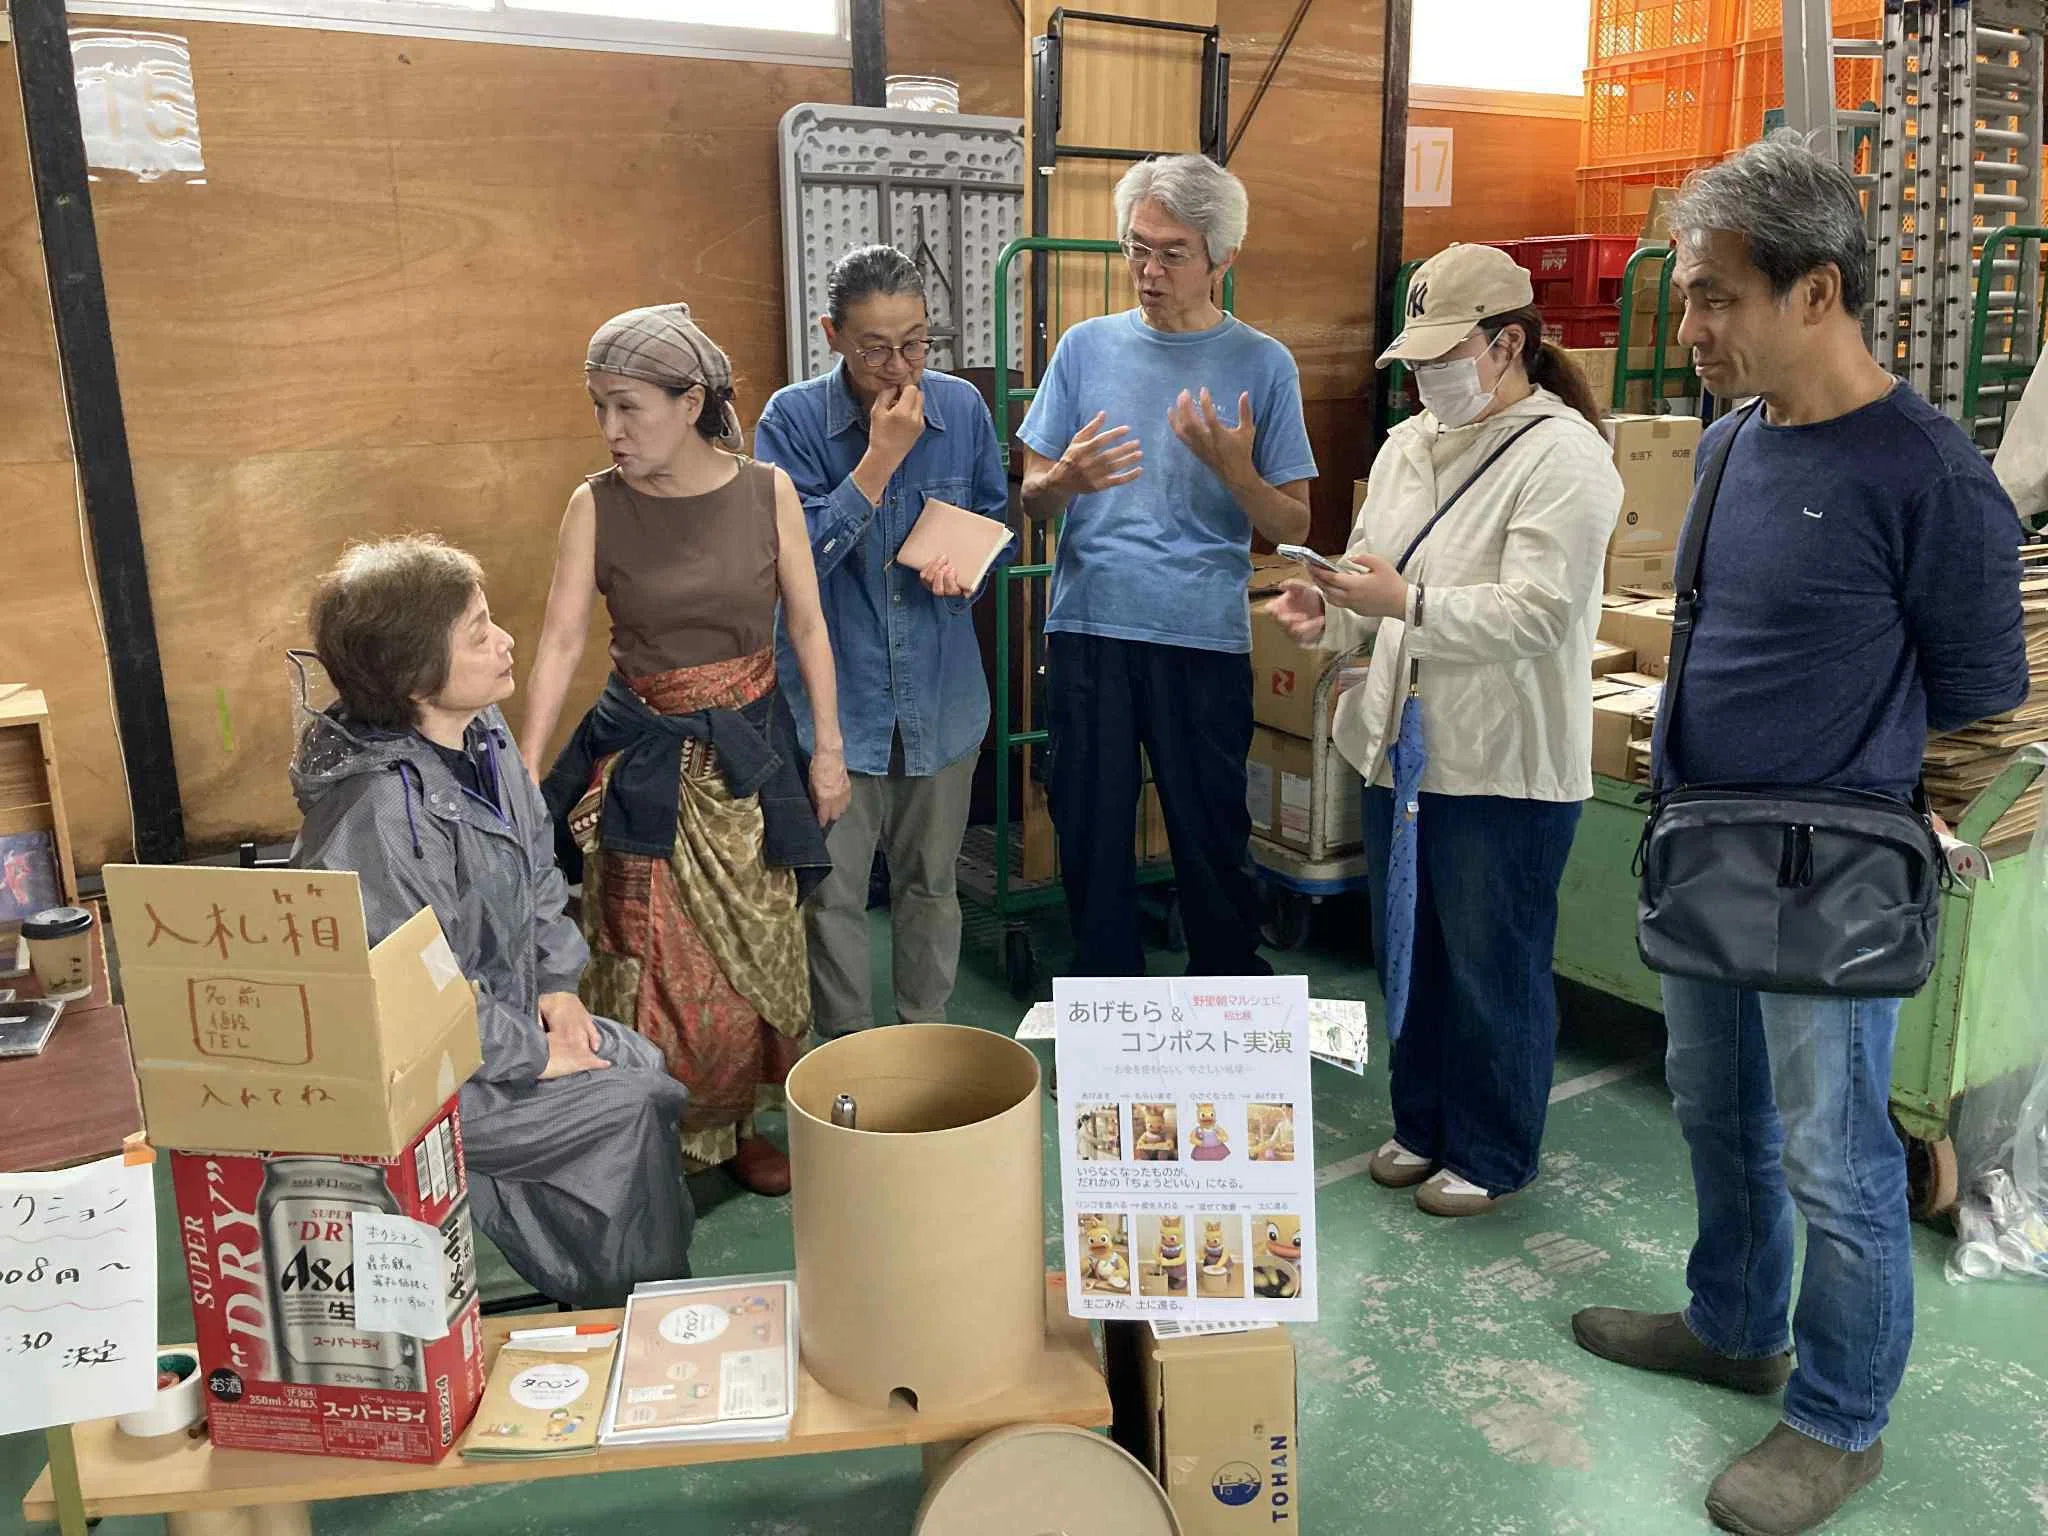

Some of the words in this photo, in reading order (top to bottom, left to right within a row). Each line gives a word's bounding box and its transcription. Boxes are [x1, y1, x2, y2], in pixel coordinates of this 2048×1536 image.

[1410, 140, 1450, 193] 17
[144, 883, 340, 961] 入札箱
[205, 984, 261, 1009] 名前
[1068, 1000, 1163, 1024] あげもら
[1170, 1007, 1184, 1023] &
[205, 1031, 250, 1049] TEL
[1120, 1029, 1294, 1055] コンポスト実演
[200, 1083, 337, 1109] 入れてね
[0, 1188, 128, 1226] クション
[184, 1214, 216, 1310] SUPER
[281, 1244, 355, 1293] Asa
[328, 1300, 355, 1321] 生
[61, 1338, 128, 1369] 決定
[312, 1336, 381, 1351] スーパードライ
[209, 1376, 242, 1395] お酒
[323, 1401, 426, 1424] スーパードライ
[1270, 1435, 1289, 1524] TOHAN
